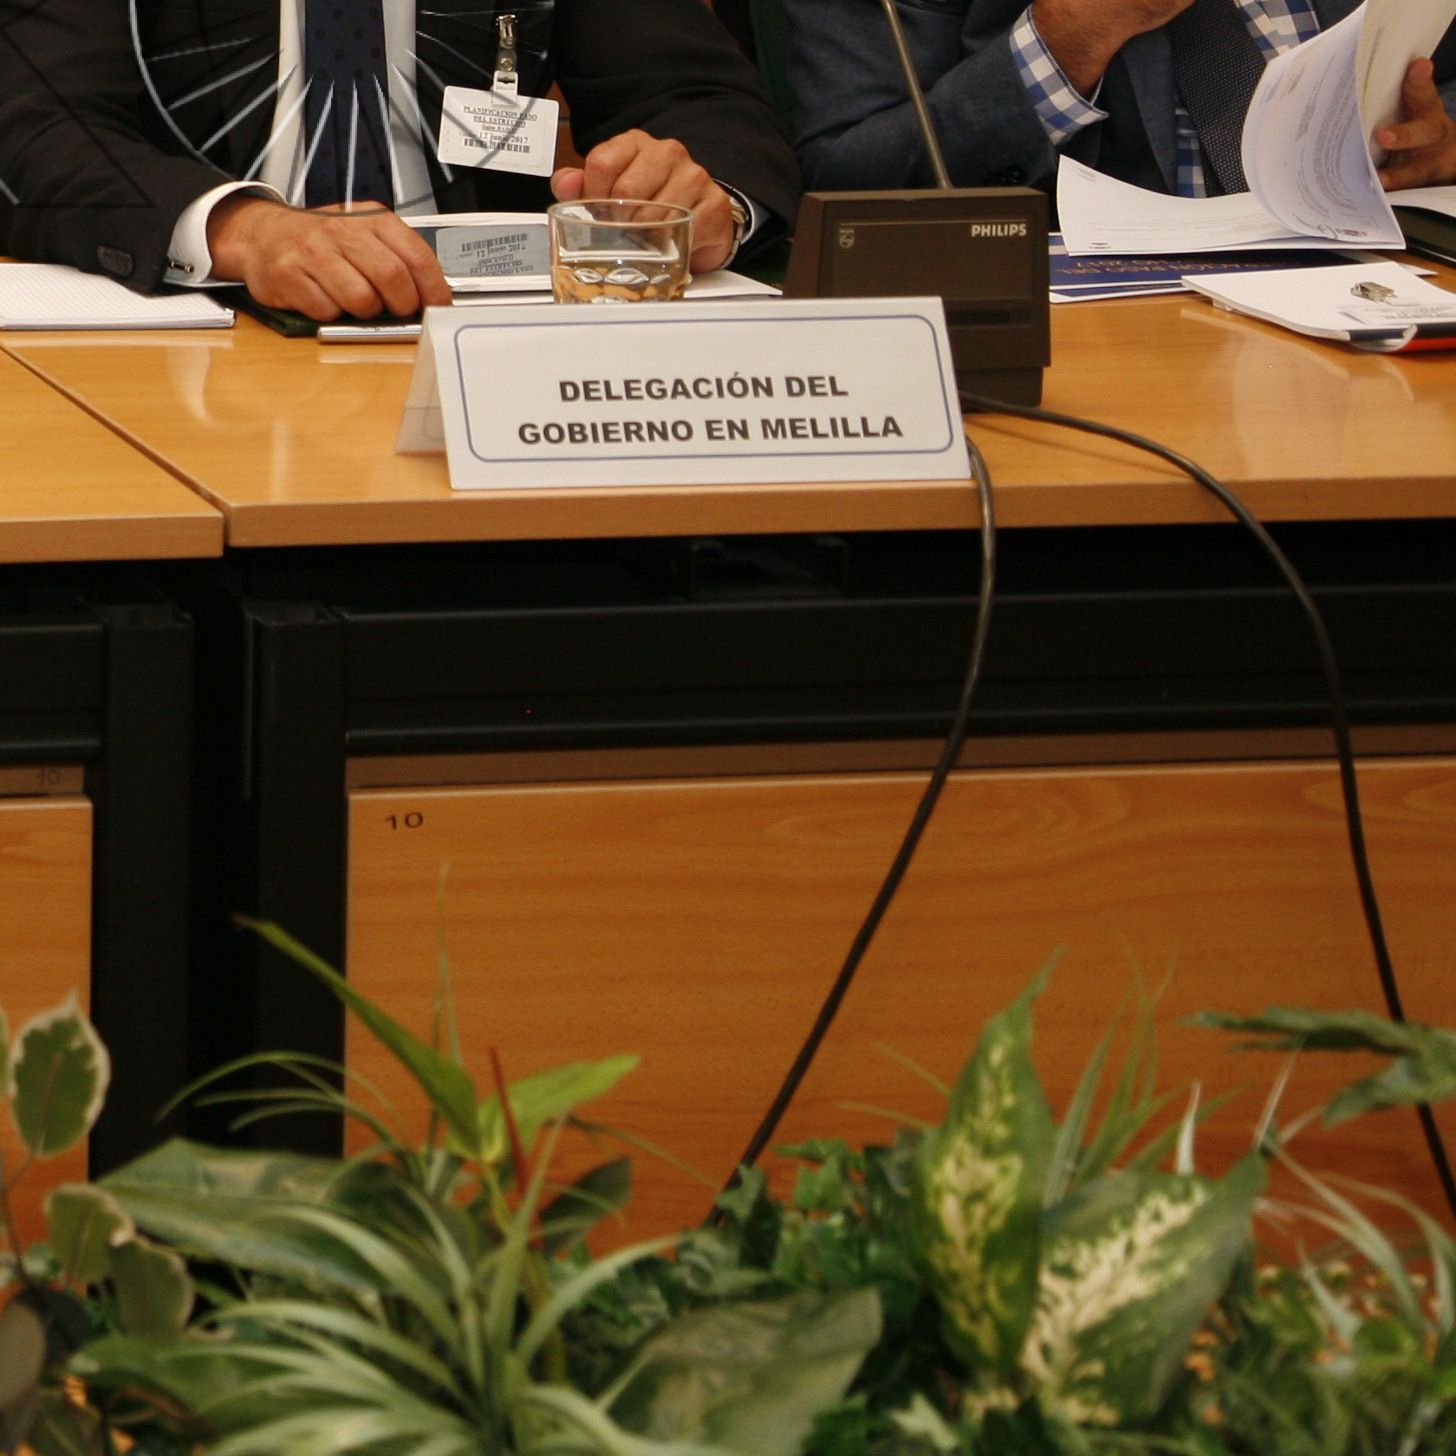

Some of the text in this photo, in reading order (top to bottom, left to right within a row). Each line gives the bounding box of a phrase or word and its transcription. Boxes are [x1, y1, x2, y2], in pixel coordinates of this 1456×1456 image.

[971, 224, 1027, 237] PHILIPS
[559, 372, 848, 402] DELEGACIÓN DEL
[518, 415, 903, 445] GOBIERNO EN MELILLA
[385, 811, 424, 830] 10
